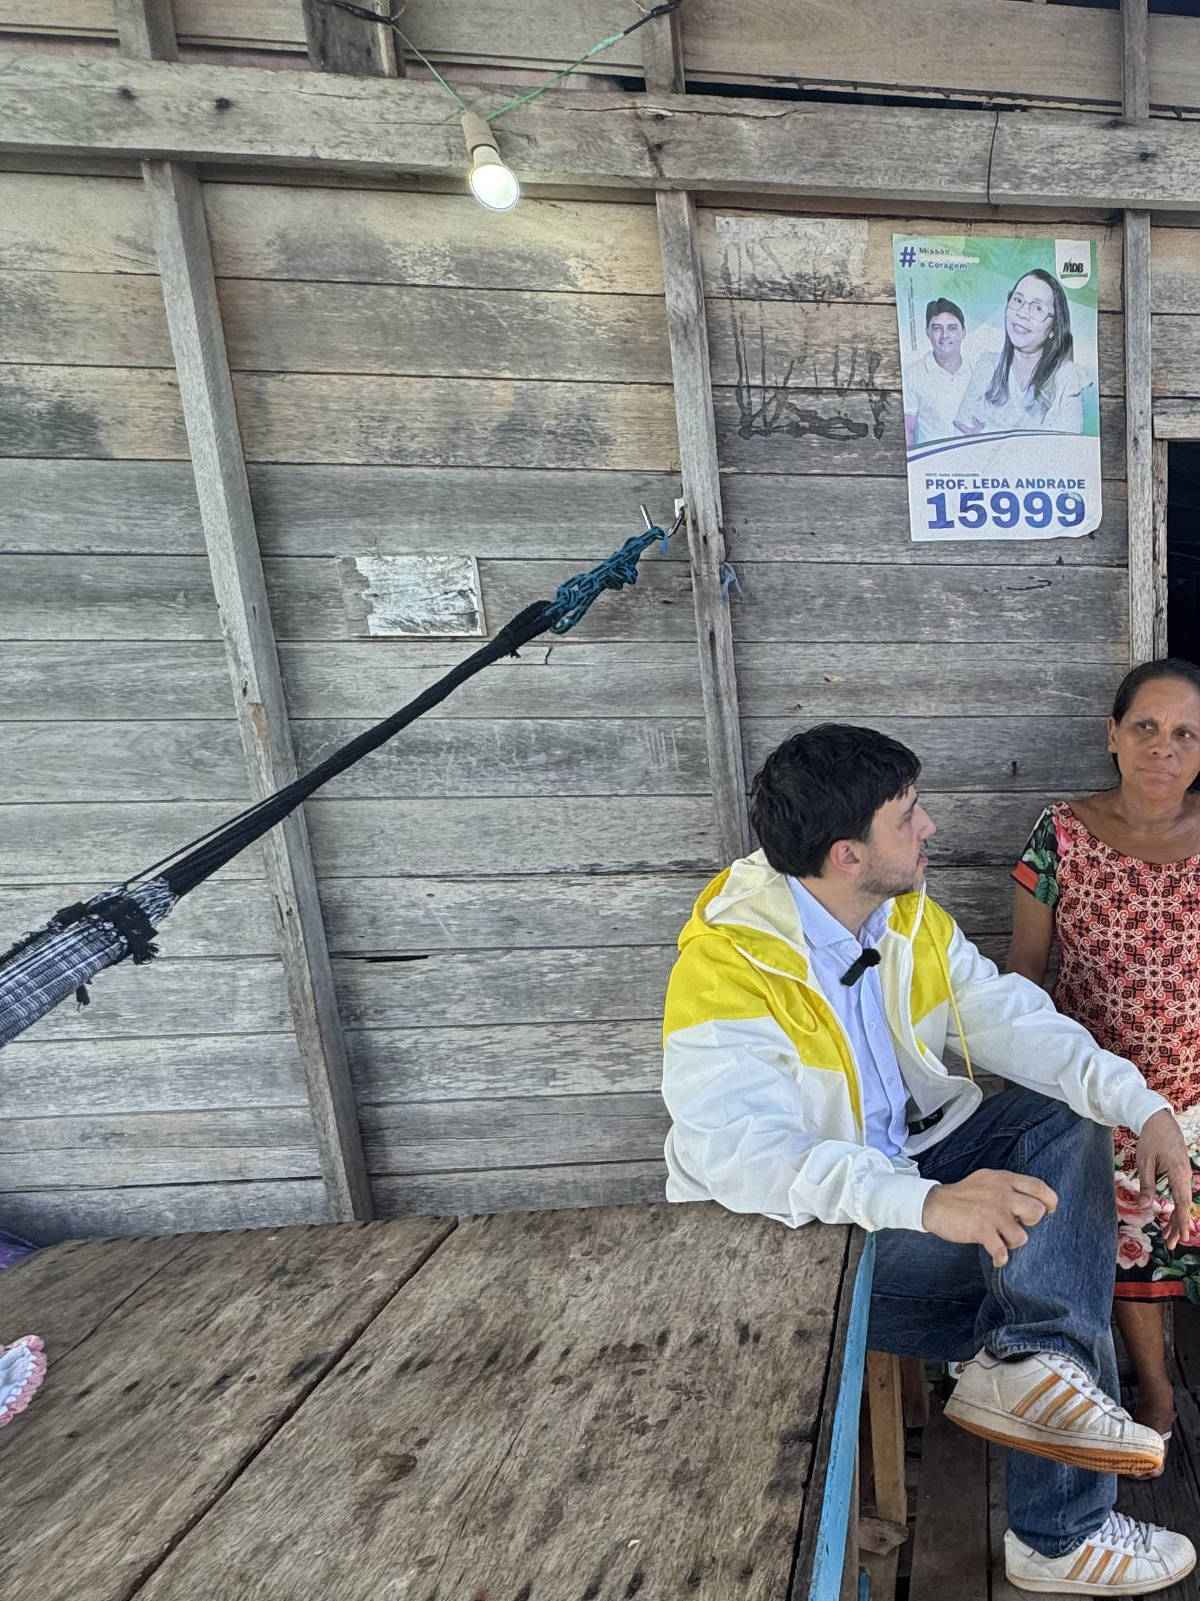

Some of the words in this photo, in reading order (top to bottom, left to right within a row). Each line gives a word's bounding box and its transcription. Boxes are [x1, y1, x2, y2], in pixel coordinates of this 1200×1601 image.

[928, 261, 968, 271] Coragem
[1063, 259, 1084, 273] MDB
[925, 478, 968, 490] PROF.
[972, 478, 1011, 490] LEDA
[1014, 478, 1086, 490] ANDRADE
[926, 491, 1086, 529] 15999
